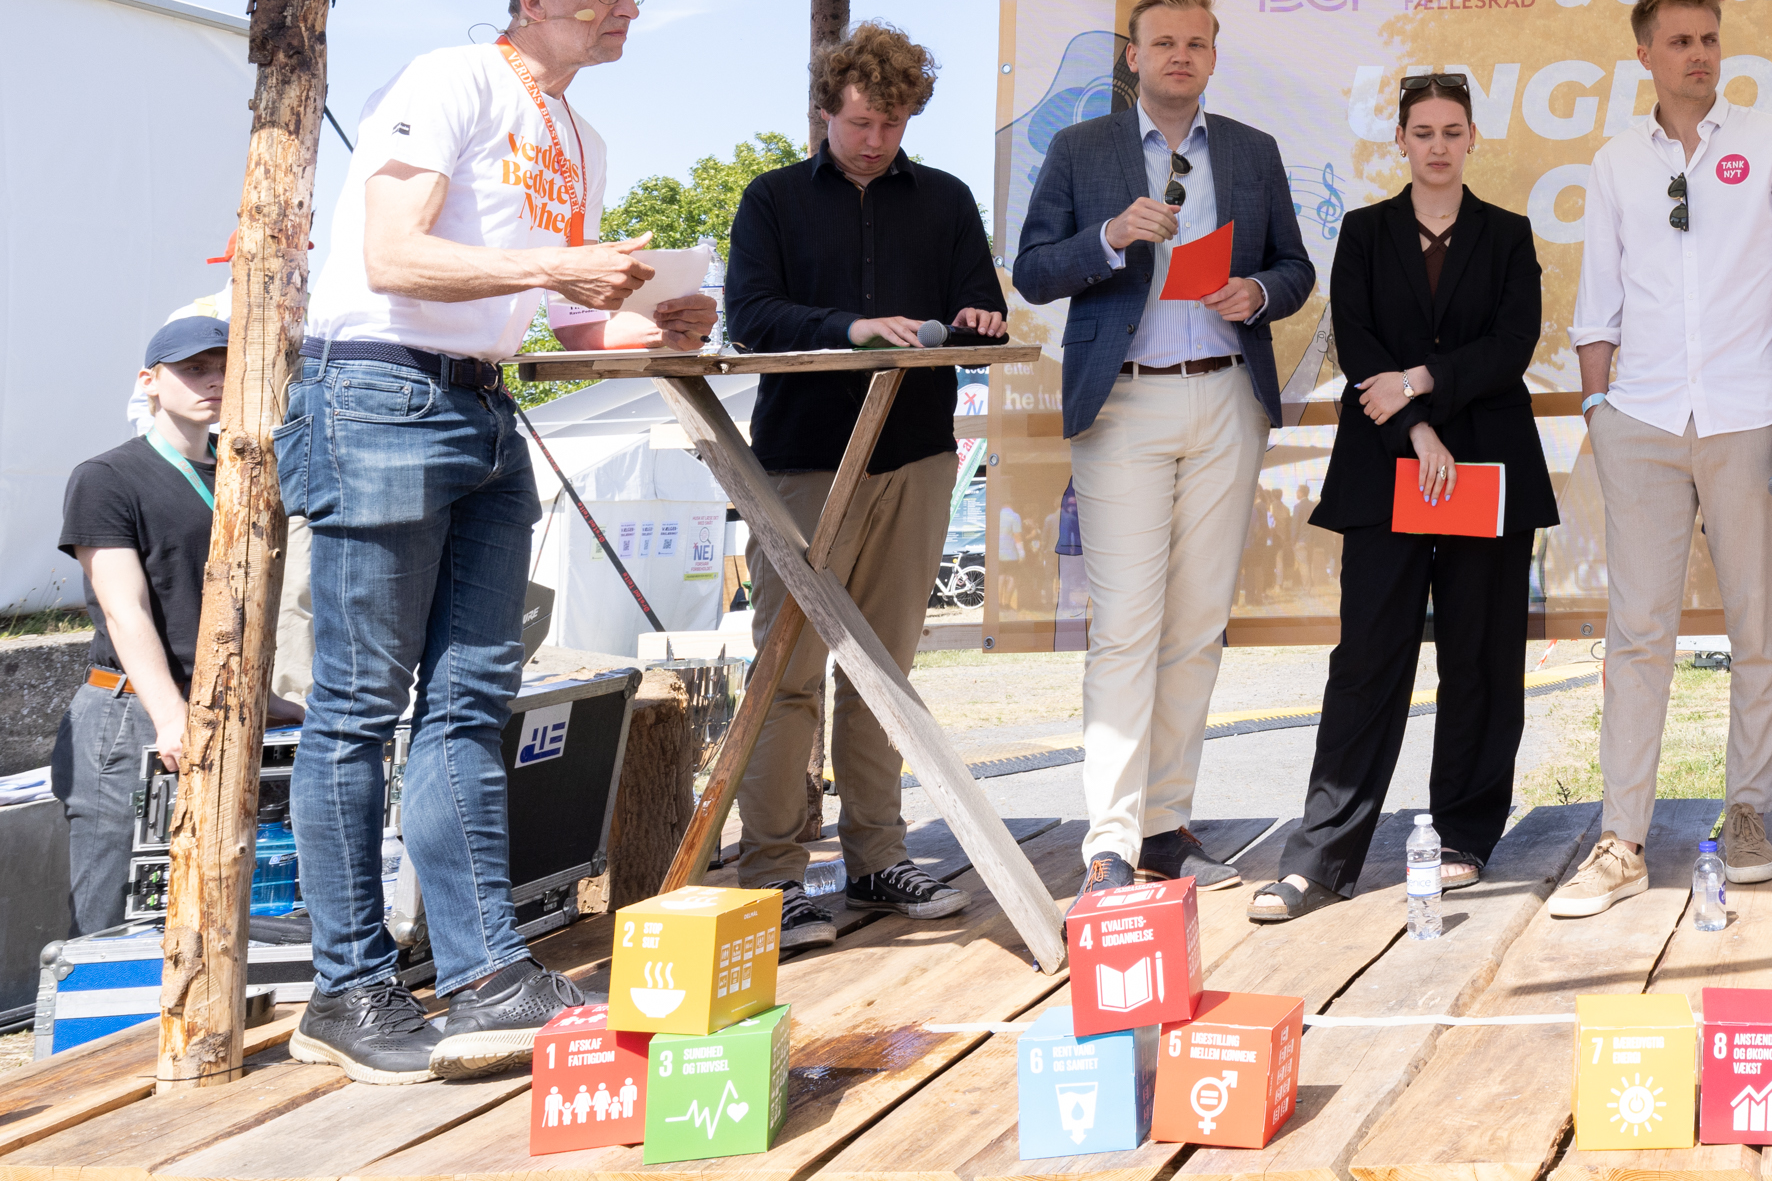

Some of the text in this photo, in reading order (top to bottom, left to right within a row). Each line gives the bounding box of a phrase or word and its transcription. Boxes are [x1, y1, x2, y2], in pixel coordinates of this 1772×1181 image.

[508, 51, 543, 104] VERDENS
[540, 107, 561, 152] BEDSTE
[1721, 161, 1744, 169] TÆNK
[1724, 170, 1742, 178] NYT
[501, 158, 569, 205] Bedste
[559, 155, 580, 213] NYHEDER
[588, 518, 605, 543] Ørsted
[694, 545, 714, 561] NEJ
[633, 587, 650, 613] Ørsted
[622, 921, 663, 947] 2 STOP
[642, 937, 660, 948] SULT
[1079, 916, 1147, 950] 4 KVALITETS-
[1102, 929, 1154, 948] UDDANNELSE
[546, 1038, 602, 1069] 1 AFSKAF
[1168, 1031, 1240, 1057] 5 LIGESTILLING
[1190, 1047, 1257, 1063] MELLEM KØNNENE
[1592, 1037, 1603, 1064] 7
[1713, 1033, 1727, 1059] 8
[1733, 1048, 1746, 1060] OG
[568, 1051, 615, 1067] FATTIGDOM
[659, 1046, 723, 1077] 3 SUNDHED
[683, 1059, 729, 1075] OG TRIVSEL
[1029, 1044, 1095, 1074] 6 RENT VAND
[1053, 1058, 1098, 1072] OG SANITET
[1733, 1062, 1762, 1075] VÆKST
